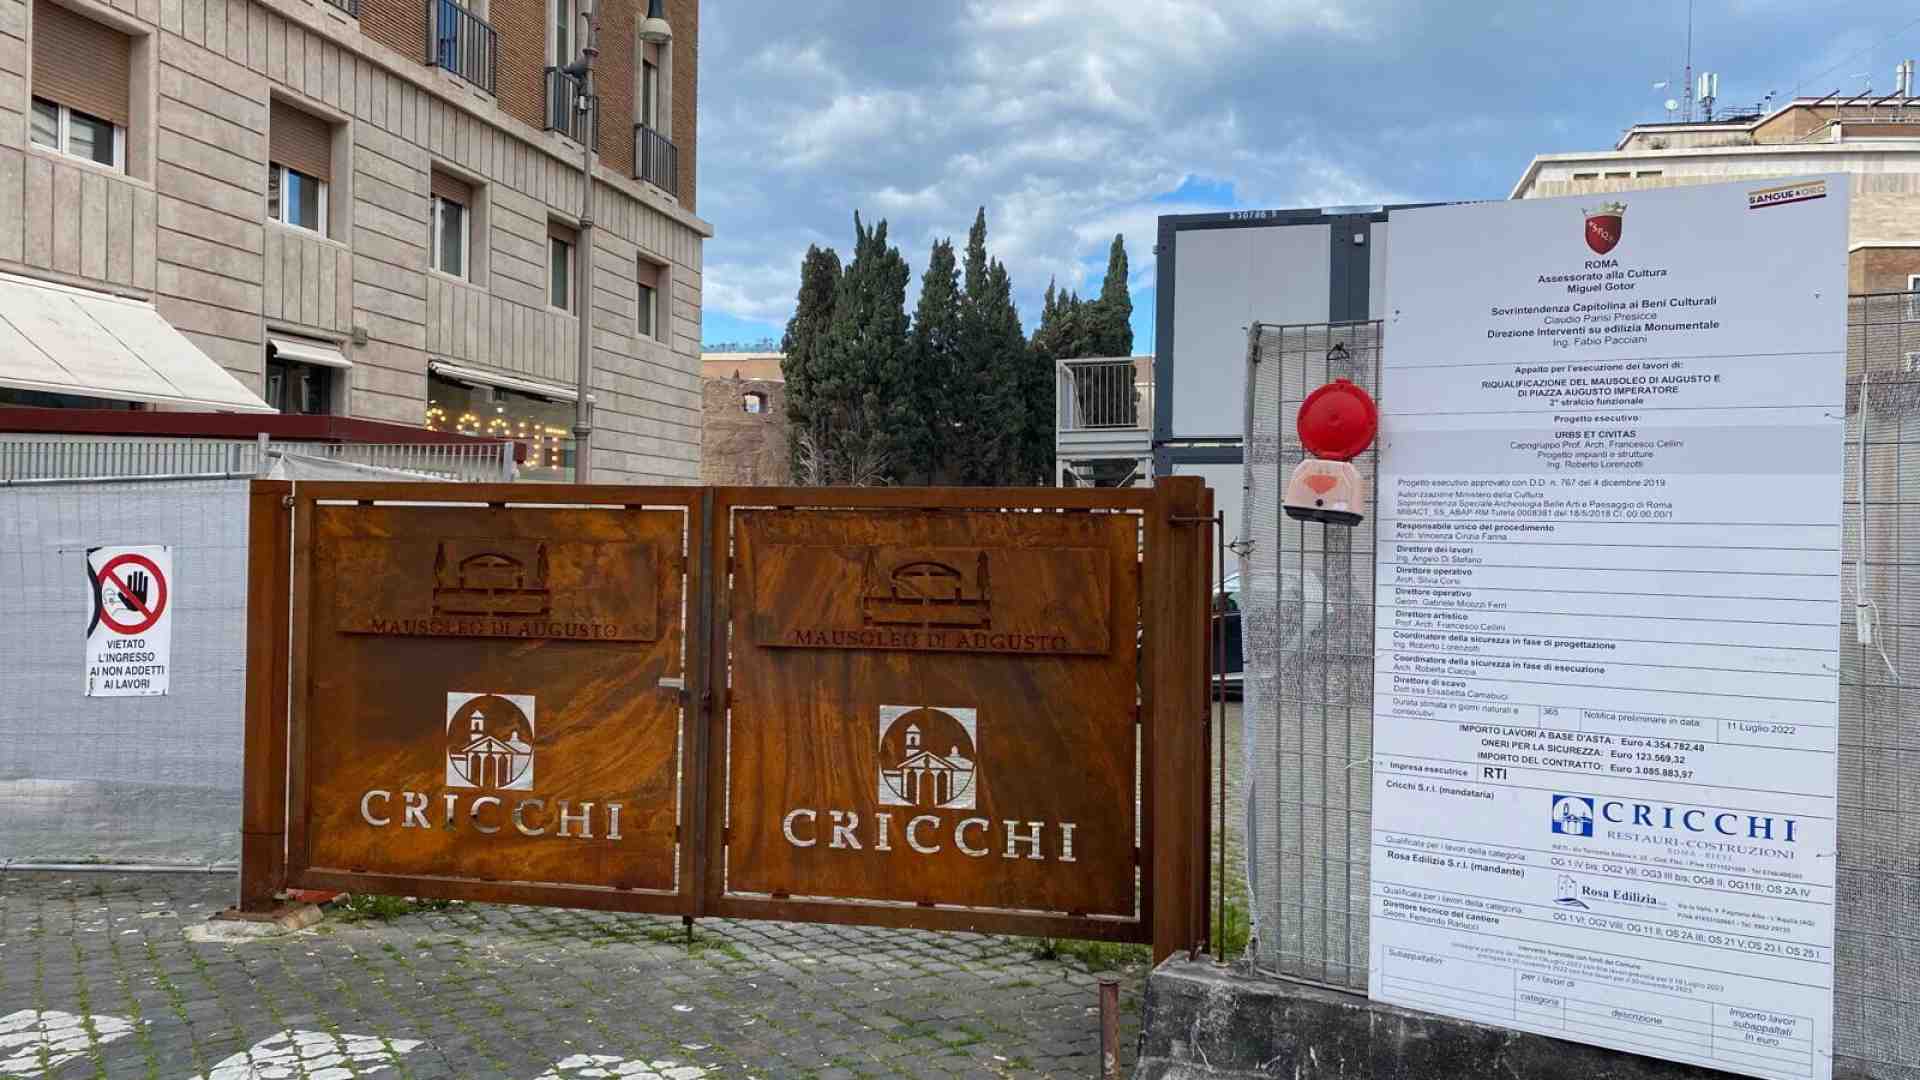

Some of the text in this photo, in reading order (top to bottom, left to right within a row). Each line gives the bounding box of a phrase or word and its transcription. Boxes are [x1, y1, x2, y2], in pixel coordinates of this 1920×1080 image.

[1749, 190, 1794, 204] SANGUE
[1584, 259, 1618, 269] ROMA
[1538, 269, 1667, 284] Assessorato alla Cultura
[1567, 282, 1635, 295] Miguel Gotor
[1491, 296, 1717, 316] Sovrintendenza Capitolina ai Beni Culturali
[1544, 312, 1657, 325] Claudio Parisi Presicce
[1487, 320, 1720, 338] Direzione Interventi su edilizia Monumentale
[1553, 334, 1648, 349] Ing. Fabio Pacciani
[1514, 361, 1668, 375] Appalto per dei lavori
[1482, 375, 1720, 389] RIQUALIFICAZIONE DEL MAUSOLEO DI AUGUSTO E
[1518, 385, 1679, 397] DI PIAZZA AUGUSTO IMPERATORE
[1560, 397, 1644, 407] stralcio funzionale
[1554, 414, 1592, 425] Progetto
[1555, 430, 1637, 439] URBS ET CIVITAS
[1510, 440, 1654, 451] Capogruppo Francesco
[1537, 450, 1572, 460] Progetto
[1565, 460, 1598, 468] Roberto
[1470, 478, 1510, 488] approvato
[1601, 478, 1641, 486] dicembre
[1642, 478, 1666, 486] 2019
[1396, 521, 1451, 531] Responsabile
[1494, 524, 1554, 532] procedimento
[1396, 545, 1432, 553] Direttore
[1396, 566, 1472, 576] Direttore operativo
[1396, 587, 1472, 598] Direttore operativo
[1395, 610, 1468, 620] Direttore artistico
[371, 618, 618, 638] MAUSOLEO DI AUGUSTO
[107, 639, 145, 649] VIETATO
[794, 630, 1066, 650] MAUSOLEO DI AUGUSTO
[1393, 631, 1616, 650] Coordinatore della sicurezza in fase di progettazione
[98, 652, 155, 663] L'INGRESSO
[1393, 653, 1605, 674] Coordinatore della sicurezza in fase di esecuzione
[90, 665, 164, 676] AI NON ADDETTI
[104, 679, 150, 689] AI LAVORI
[1393, 675, 1466, 688] Direttore di scavo
[1584, 711, 1700, 727] Notifica preliminare in data
[1727, 721, 1796, 734] 11 Luglio 2022
[1459, 724, 1500, 735] IMPORTO
[1502, 728, 1537, 738] LAVORI
[1539, 730, 1546, 739] A
[1548, 731, 1574, 741] BASE
[1576, 733, 1615, 744] D'ASTA:
[1620, 737, 1644, 747] Euro
[1481, 738, 1510, 748] ONERI
[1511, 741, 1530, 750] PER
[1533, 743, 1545, 751] LA
[1547, 744, 1604, 756] SICUREZZA:
[1610, 749, 1633, 759] Euro
[1390, 761, 1468, 776] Impresa esecutrice
[1477, 752, 1632, 773] IMPORTO DEL CONTRATTO: Euro
[1483, 767, 1507, 780] RTI
[1386, 780, 1494, 801] Cricchi S.r.l. (mandataria)
[360, 789, 623, 840] CRICCHI
[1602, 801, 1799, 842] CRICCHI
[783, 808, 1077, 862] CRICCHI
[1607, 830, 1795, 860] RESTAURI-COSTRUZIONI
[1387, 850, 1525, 879] Rosa Edilizia S.r.l. (mandante)
[1582, 886, 1657, 904] Rosa Edilizia
[1766, 884, 1811, 897] OS 2A IV
[1383, 899, 1500, 924] Direttore tecnico del cantiere
[1786, 946, 1800, 956] OS
[1729, 1008, 1796, 1026] Importo lavori
[1733, 1020, 1792, 1037] subappaltati
[1745, 1032, 1780, 1046] in euro
